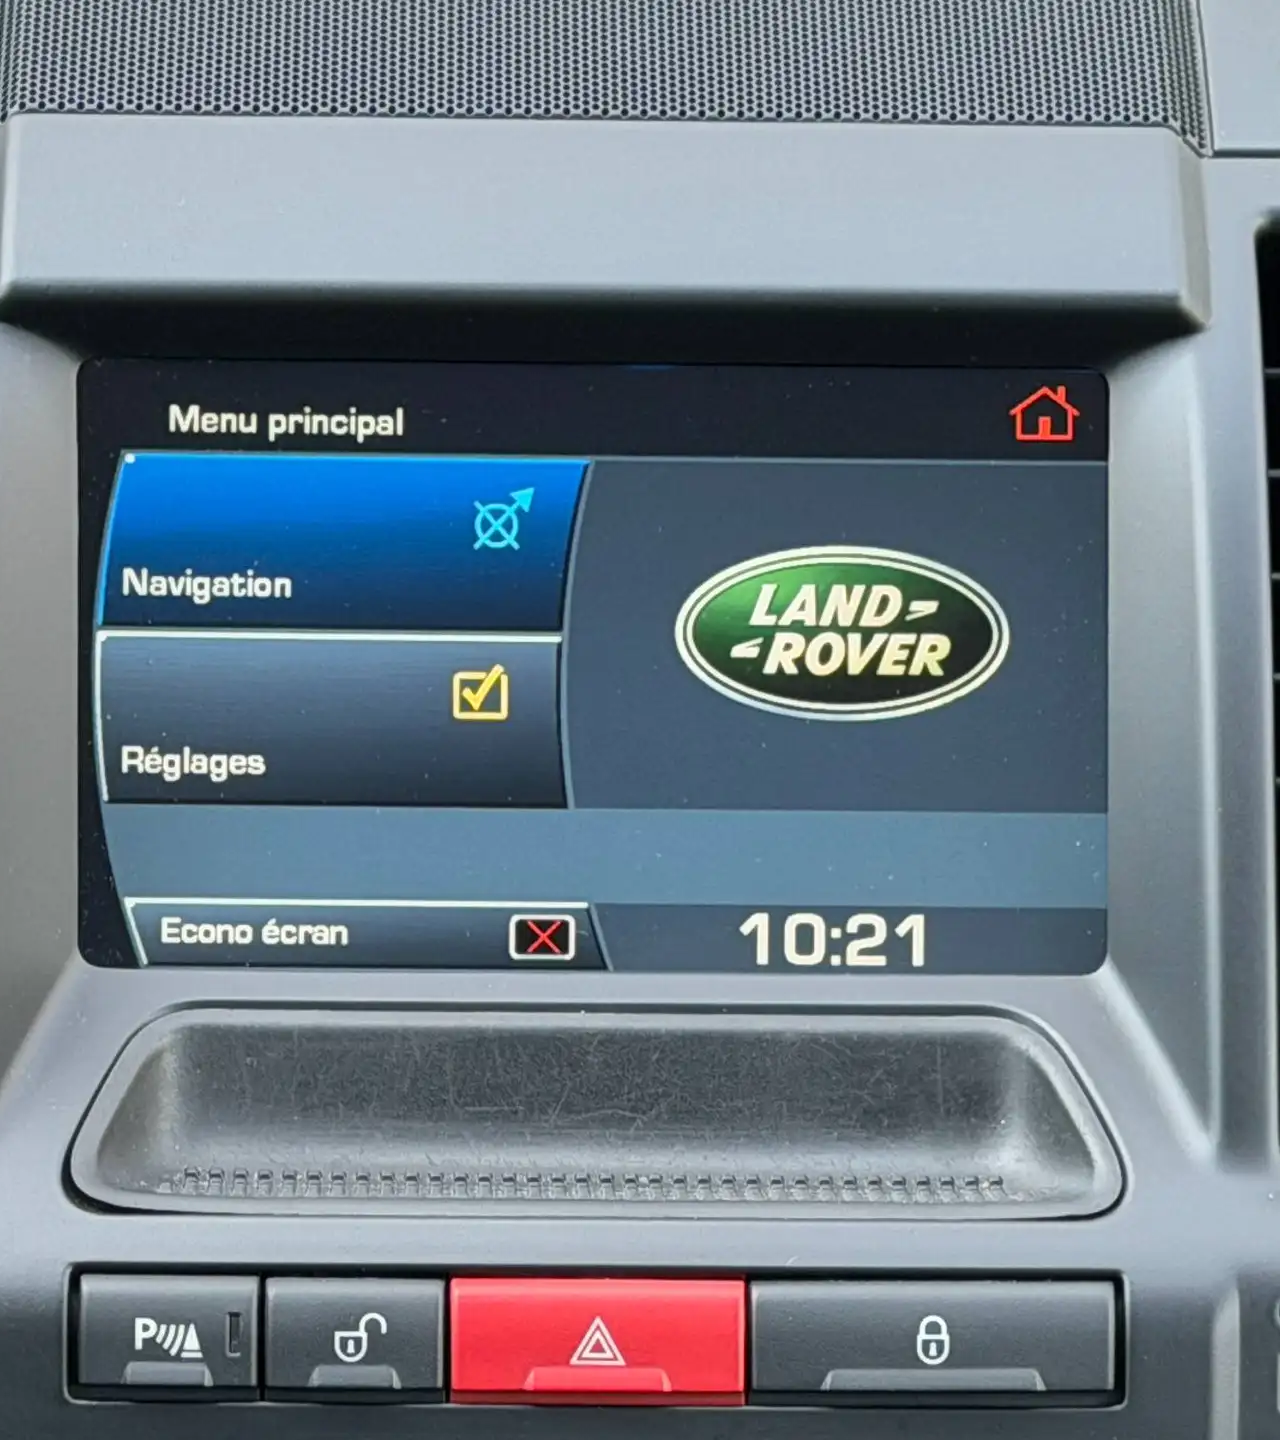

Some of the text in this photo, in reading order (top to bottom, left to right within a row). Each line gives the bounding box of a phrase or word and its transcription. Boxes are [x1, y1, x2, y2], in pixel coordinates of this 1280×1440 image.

[168, 404, 405, 443] Menu principal
[122, 567, 292, 604] Navigation
[750, 584, 904, 627] LAND
[762, 632, 951, 677] ROVER
[120, 744, 266, 783] Réglages
[160, 916, 349, 946] Econo écran
[738, 912, 926, 967] 10:21
